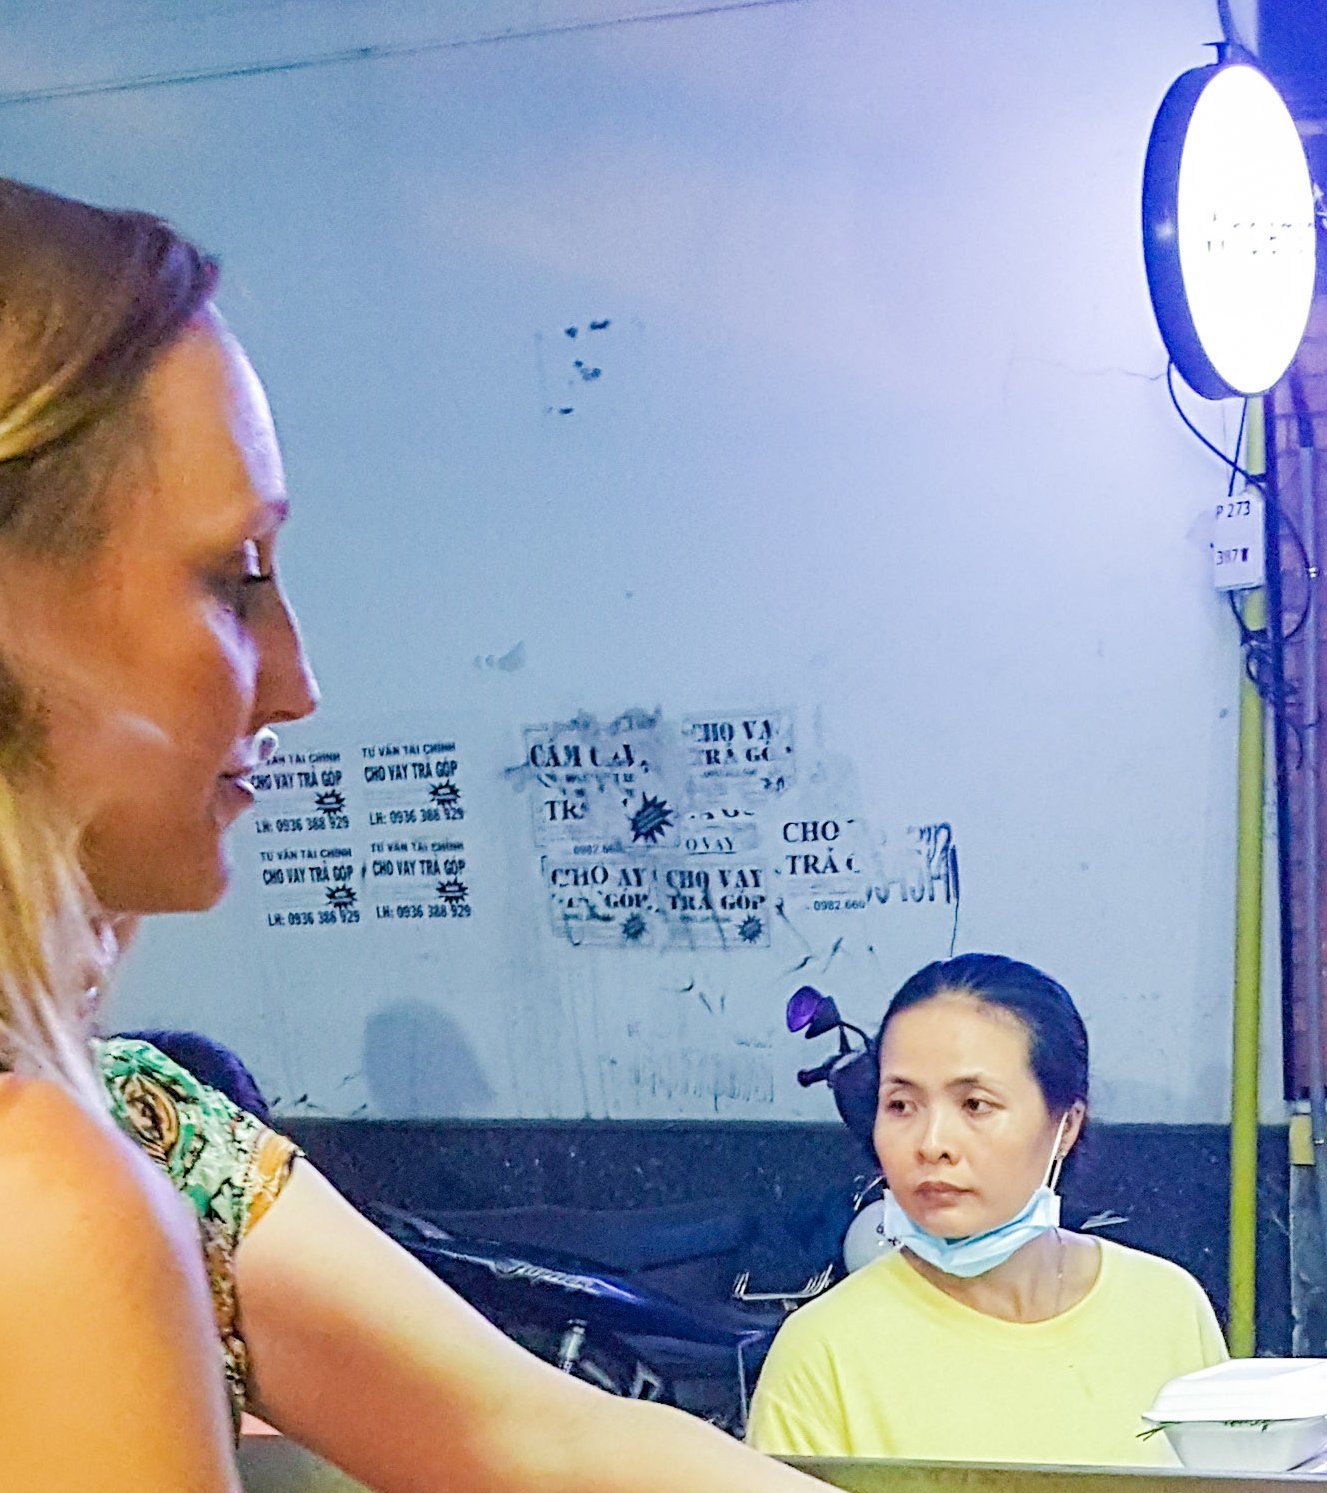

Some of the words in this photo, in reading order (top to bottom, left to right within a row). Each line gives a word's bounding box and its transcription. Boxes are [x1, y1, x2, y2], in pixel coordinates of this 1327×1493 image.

[1227, 500, 1251, 518] 273
[273, 771, 294, 790] VAY
[364, 765, 386, 783] CHO
[387, 763, 409, 781] VAY
[276, 817, 303, 832] 0936
[389, 808, 418, 824] 0936
[783, 820, 840, 843] CHO
[263, 868, 285, 886] CHO
[286, 866, 306, 884] VAY
[373, 860, 394, 877] CHO
[396, 859, 417, 877] VAY
[666, 869, 710, 889] CHO
[718, 868, 763, 889] VAY
[288, 911, 315, 926] 0936
[396, 903, 424, 919] 0936
